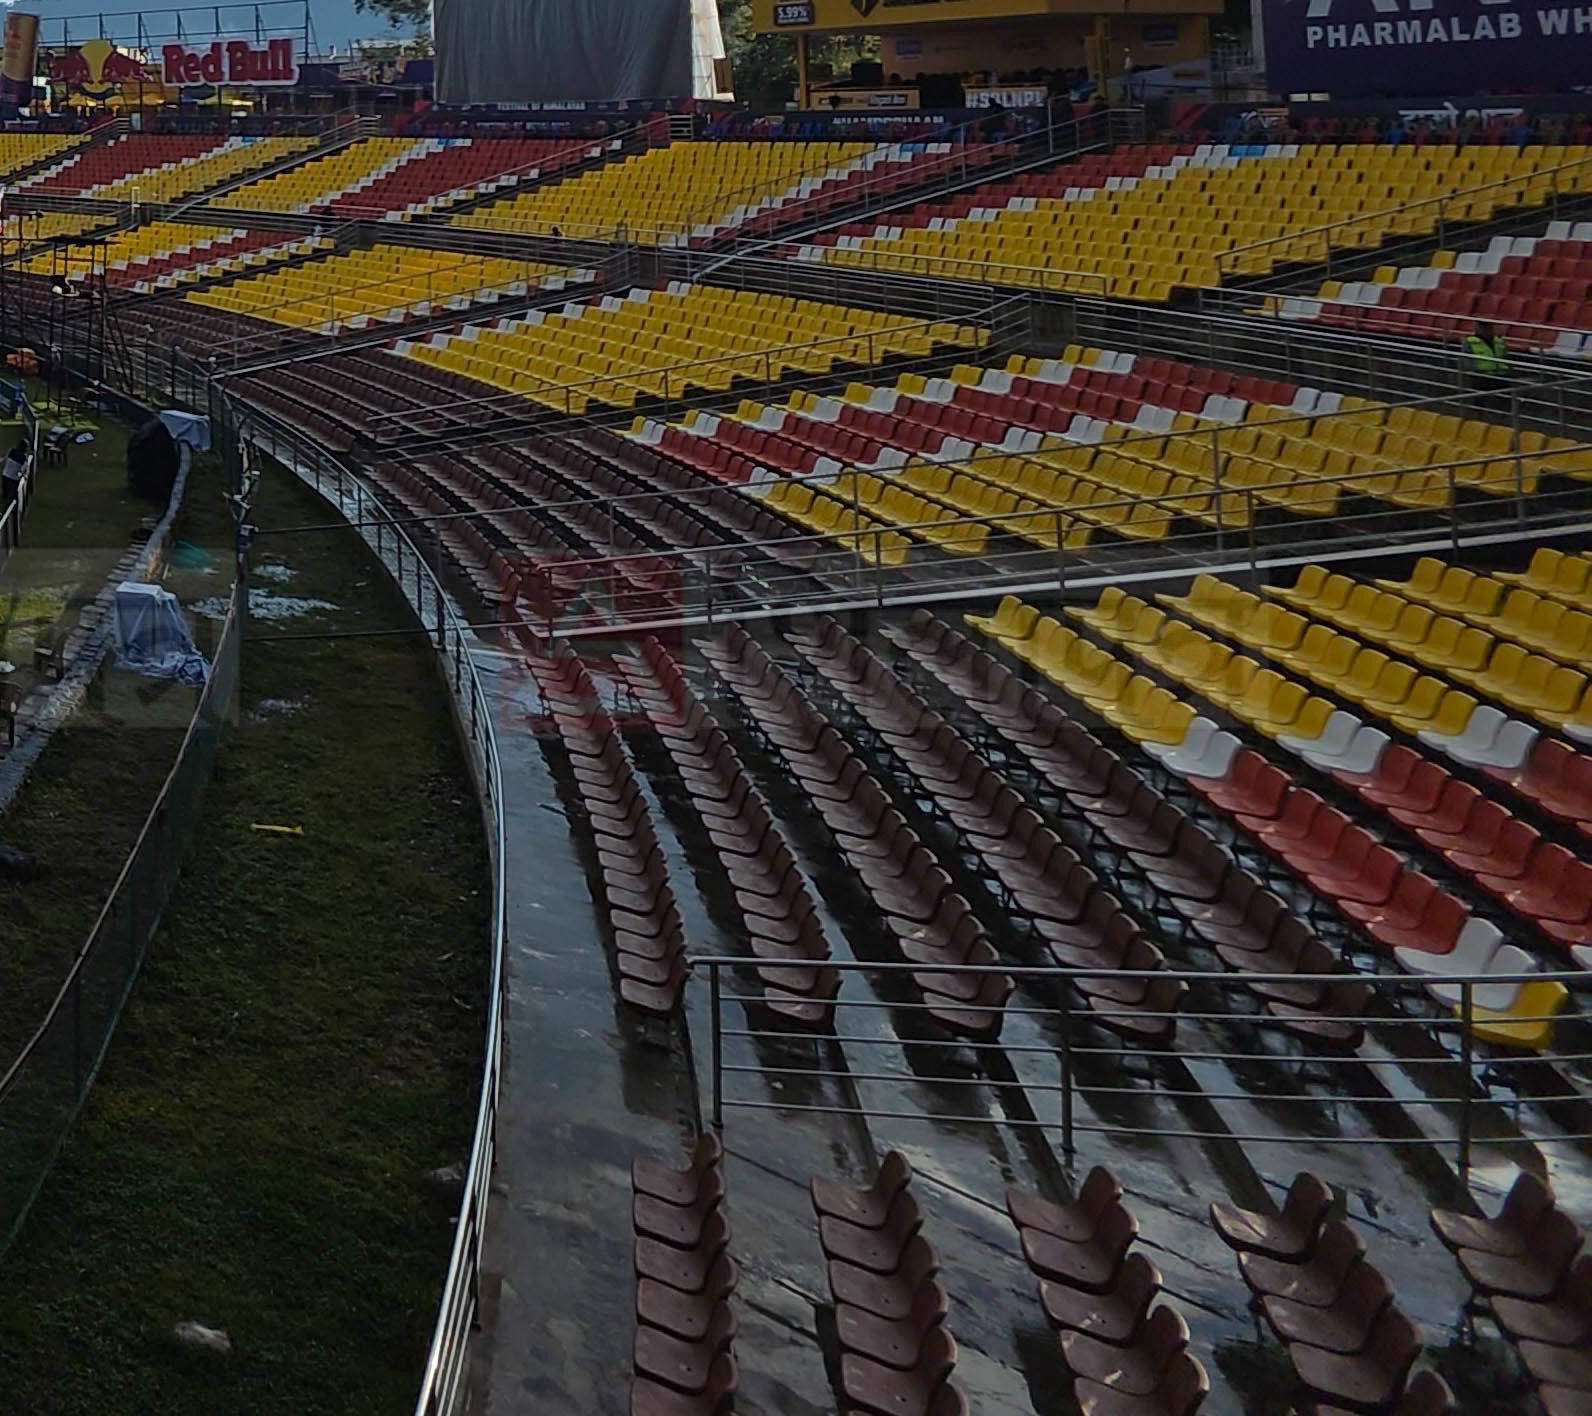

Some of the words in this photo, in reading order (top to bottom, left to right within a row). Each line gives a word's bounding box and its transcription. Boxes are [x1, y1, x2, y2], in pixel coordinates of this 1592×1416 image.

[1306, 12, 1523, 49] PHARMALAB
[162, 41, 223, 84] Red
[226, 38, 295, 83] Bull
